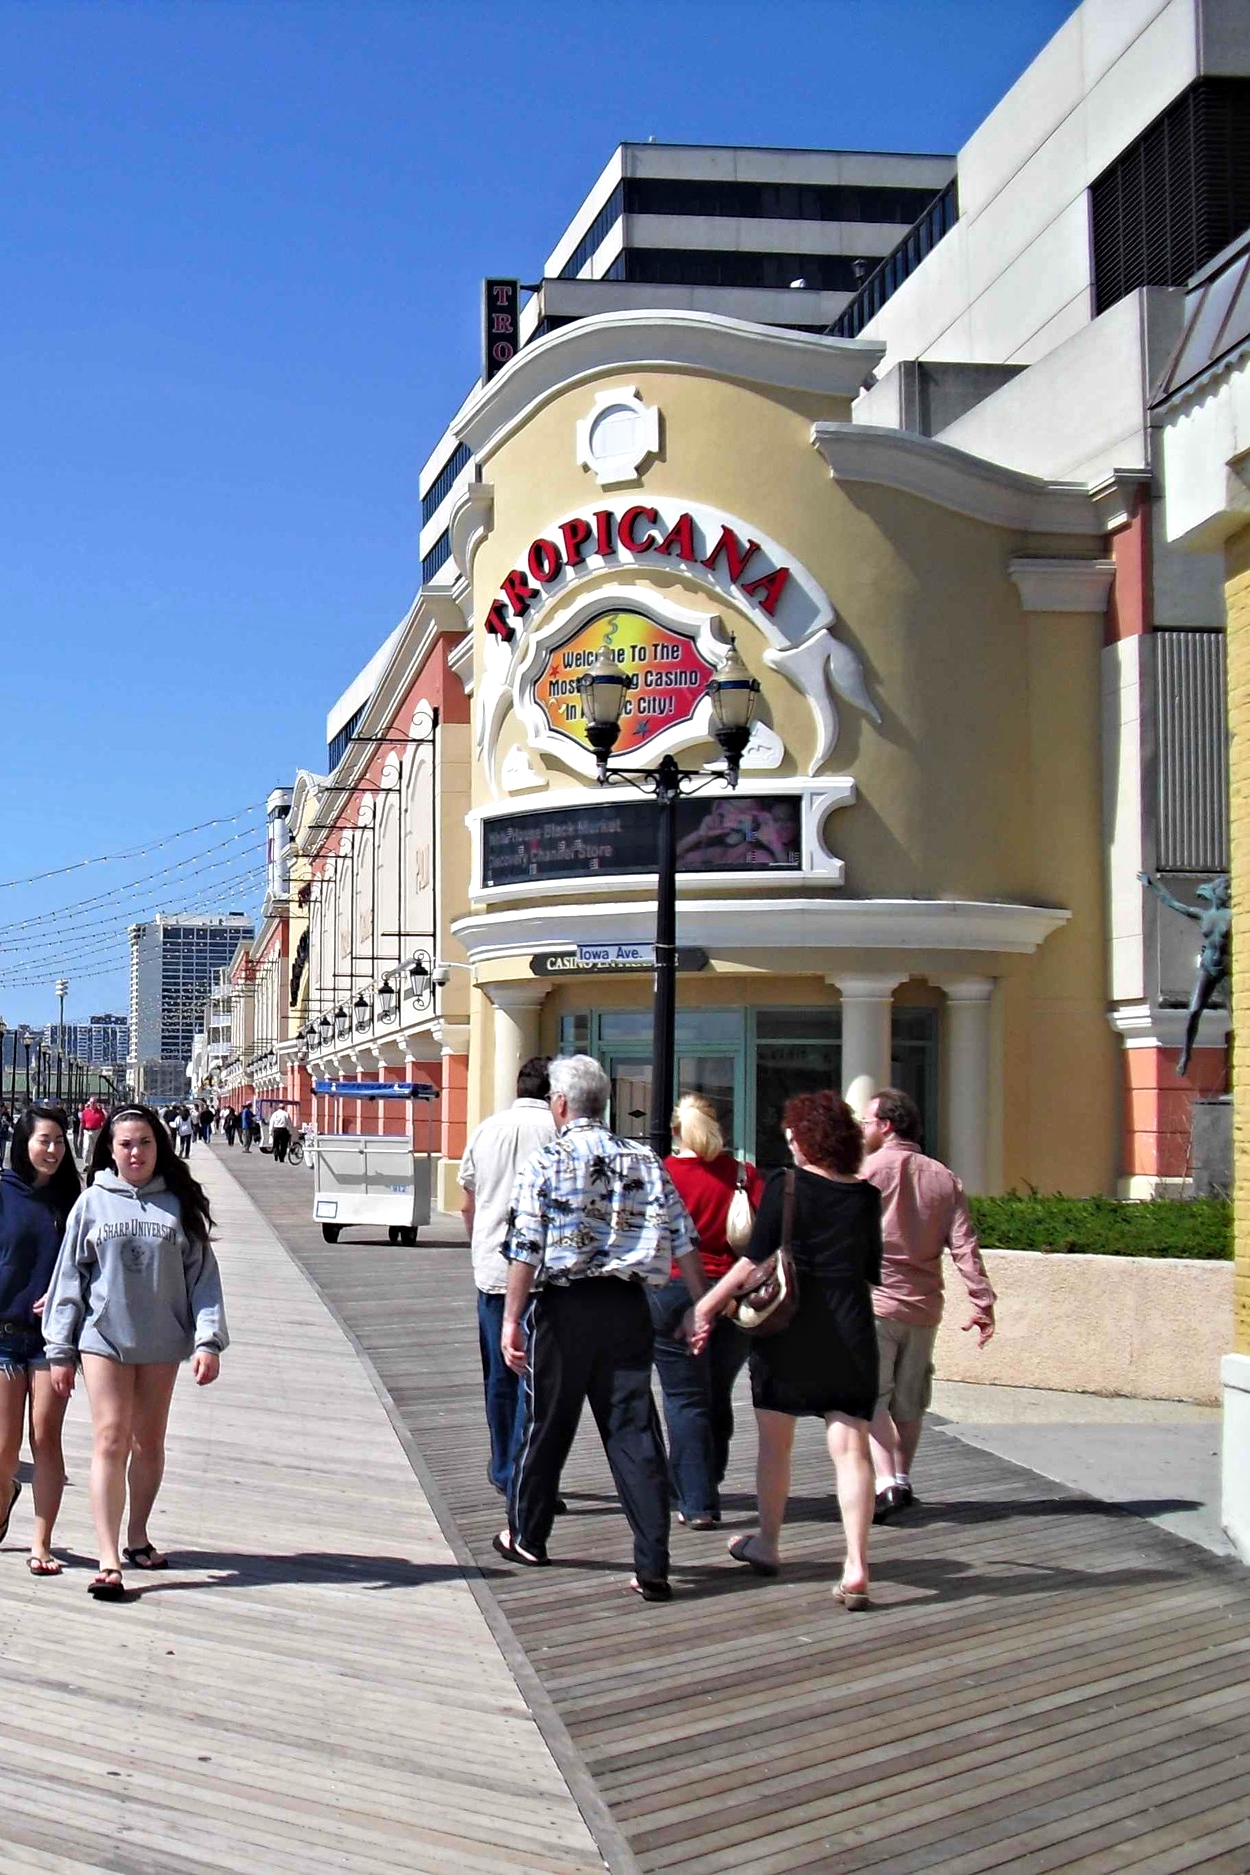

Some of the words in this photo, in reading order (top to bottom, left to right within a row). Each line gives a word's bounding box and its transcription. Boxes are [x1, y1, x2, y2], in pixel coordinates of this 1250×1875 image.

[492, 285, 514, 375] TRO
[484, 505, 791, 642] TROPICANA
[562, 648, 625, 669] Welce
[630, 645, 647, 662] To
[652, 643, 681, 661] The
[644, 669, 699, 688] Casino
[564, 703, 577, 721] In
[637, 695, 676, 716] City!
[543, 821, 575, 838] Black
[577, 844, 613, 859] Store
[579, 947, 610, 961] Iowa
[615, 946, 643, 960] Ave.
[103, 1222, 130, 1242] SHARP
[131, 1218, 177, 1246] UNIVERSITY
